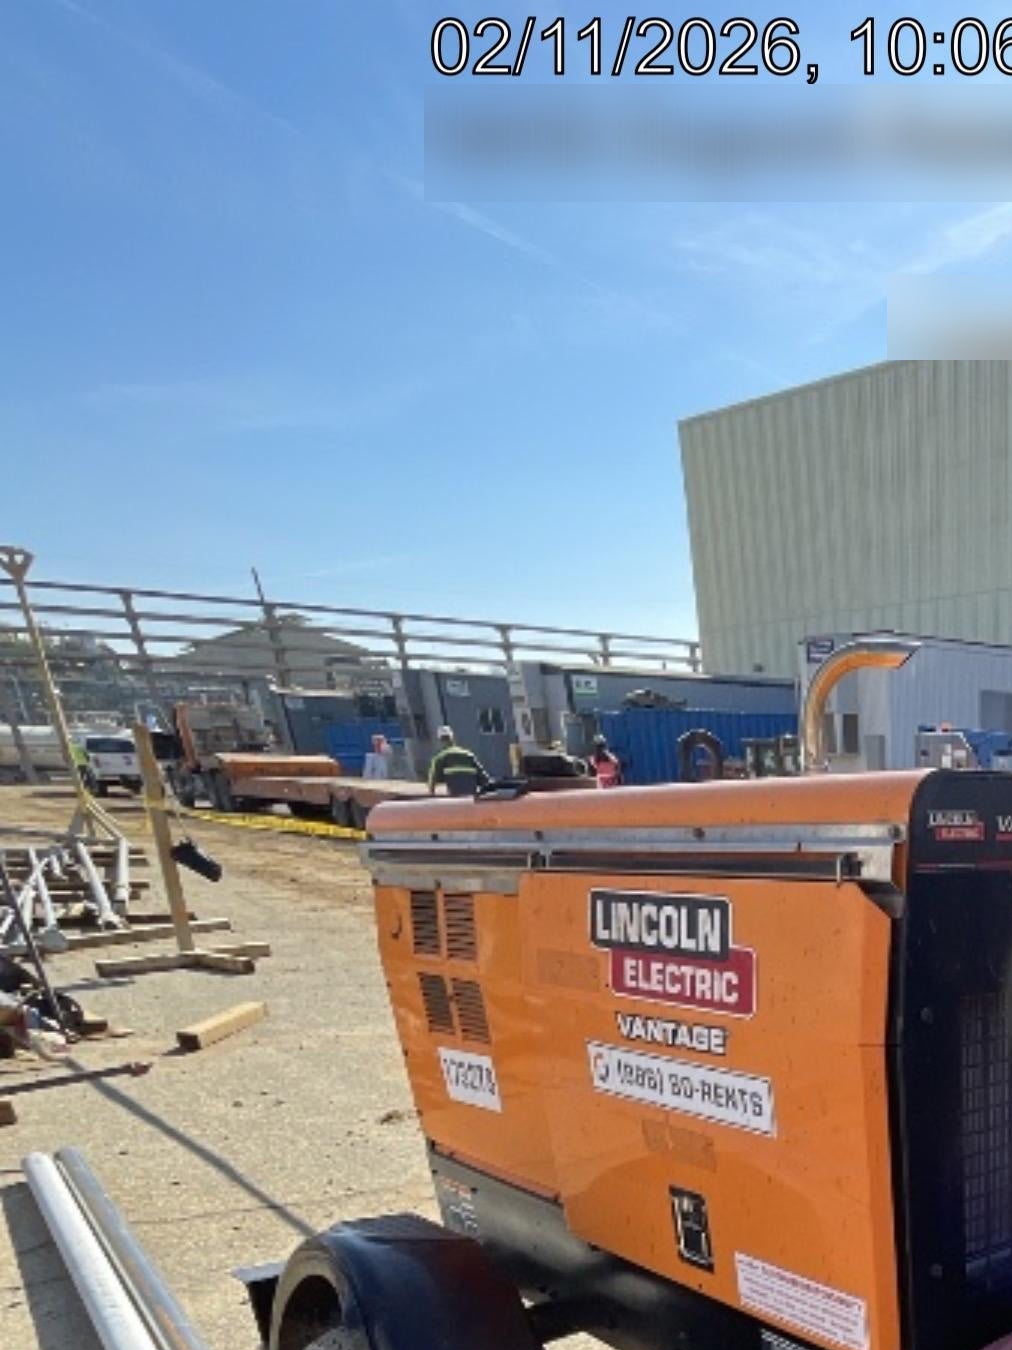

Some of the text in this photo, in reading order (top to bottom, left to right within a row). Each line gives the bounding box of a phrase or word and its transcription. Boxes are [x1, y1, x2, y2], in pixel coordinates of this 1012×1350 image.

[596, 899, 721, 953] LINCOLN
[623, 956, 739, 1003] ELECTRIC
[616, 1012, 727, 1055] VANTAGE
